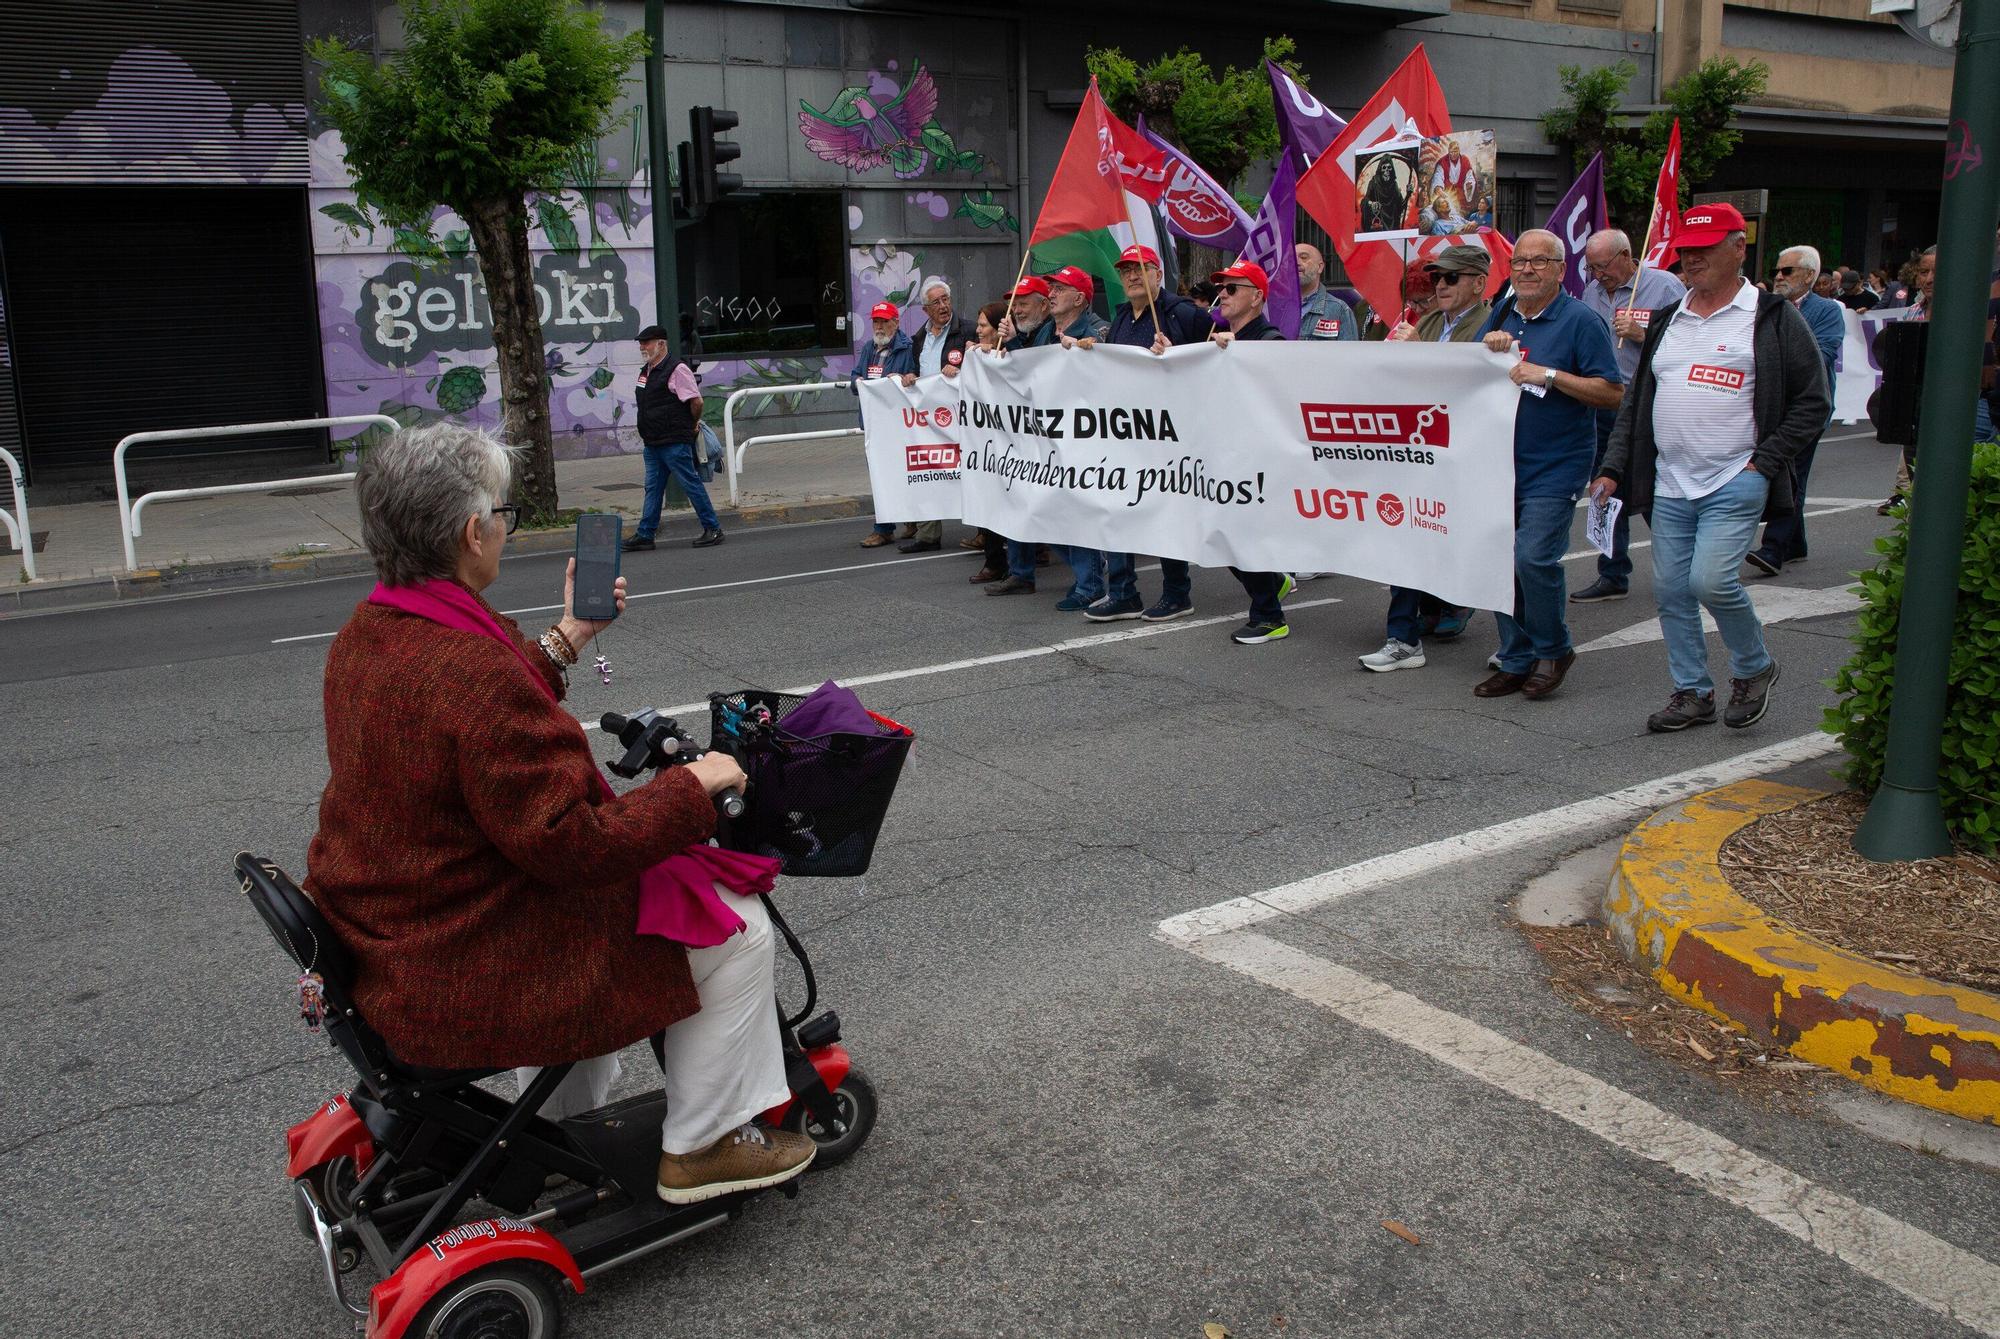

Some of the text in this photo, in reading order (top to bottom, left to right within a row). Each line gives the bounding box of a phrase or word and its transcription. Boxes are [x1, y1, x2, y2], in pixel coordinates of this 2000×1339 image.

[1686, 216, 1712, 225] CCOO
[374, 269, 624, 350] geloki
[1692, 368, 1741, 386] CCOO
[973, 401, 1006, 432] UNA
[1073, 407, 1179, 442] DIGNA
[1308, 411, 1402, 435] CCOO
[908, 449, 955, 466] CCOO
[1311, 444, 1435, 465] pensionistas
[907, 470, 961, 485] pensionista
[967, 450, 978, 470] a
[1127, 455, 1265, 507] públicos!
[1294, 488, 1369, 522] UGT
[1416, 497, 1446, 519] UJP
[1414, 516, 1448, 535] Navarra
[426, 1220, 497, 1261] Folding
